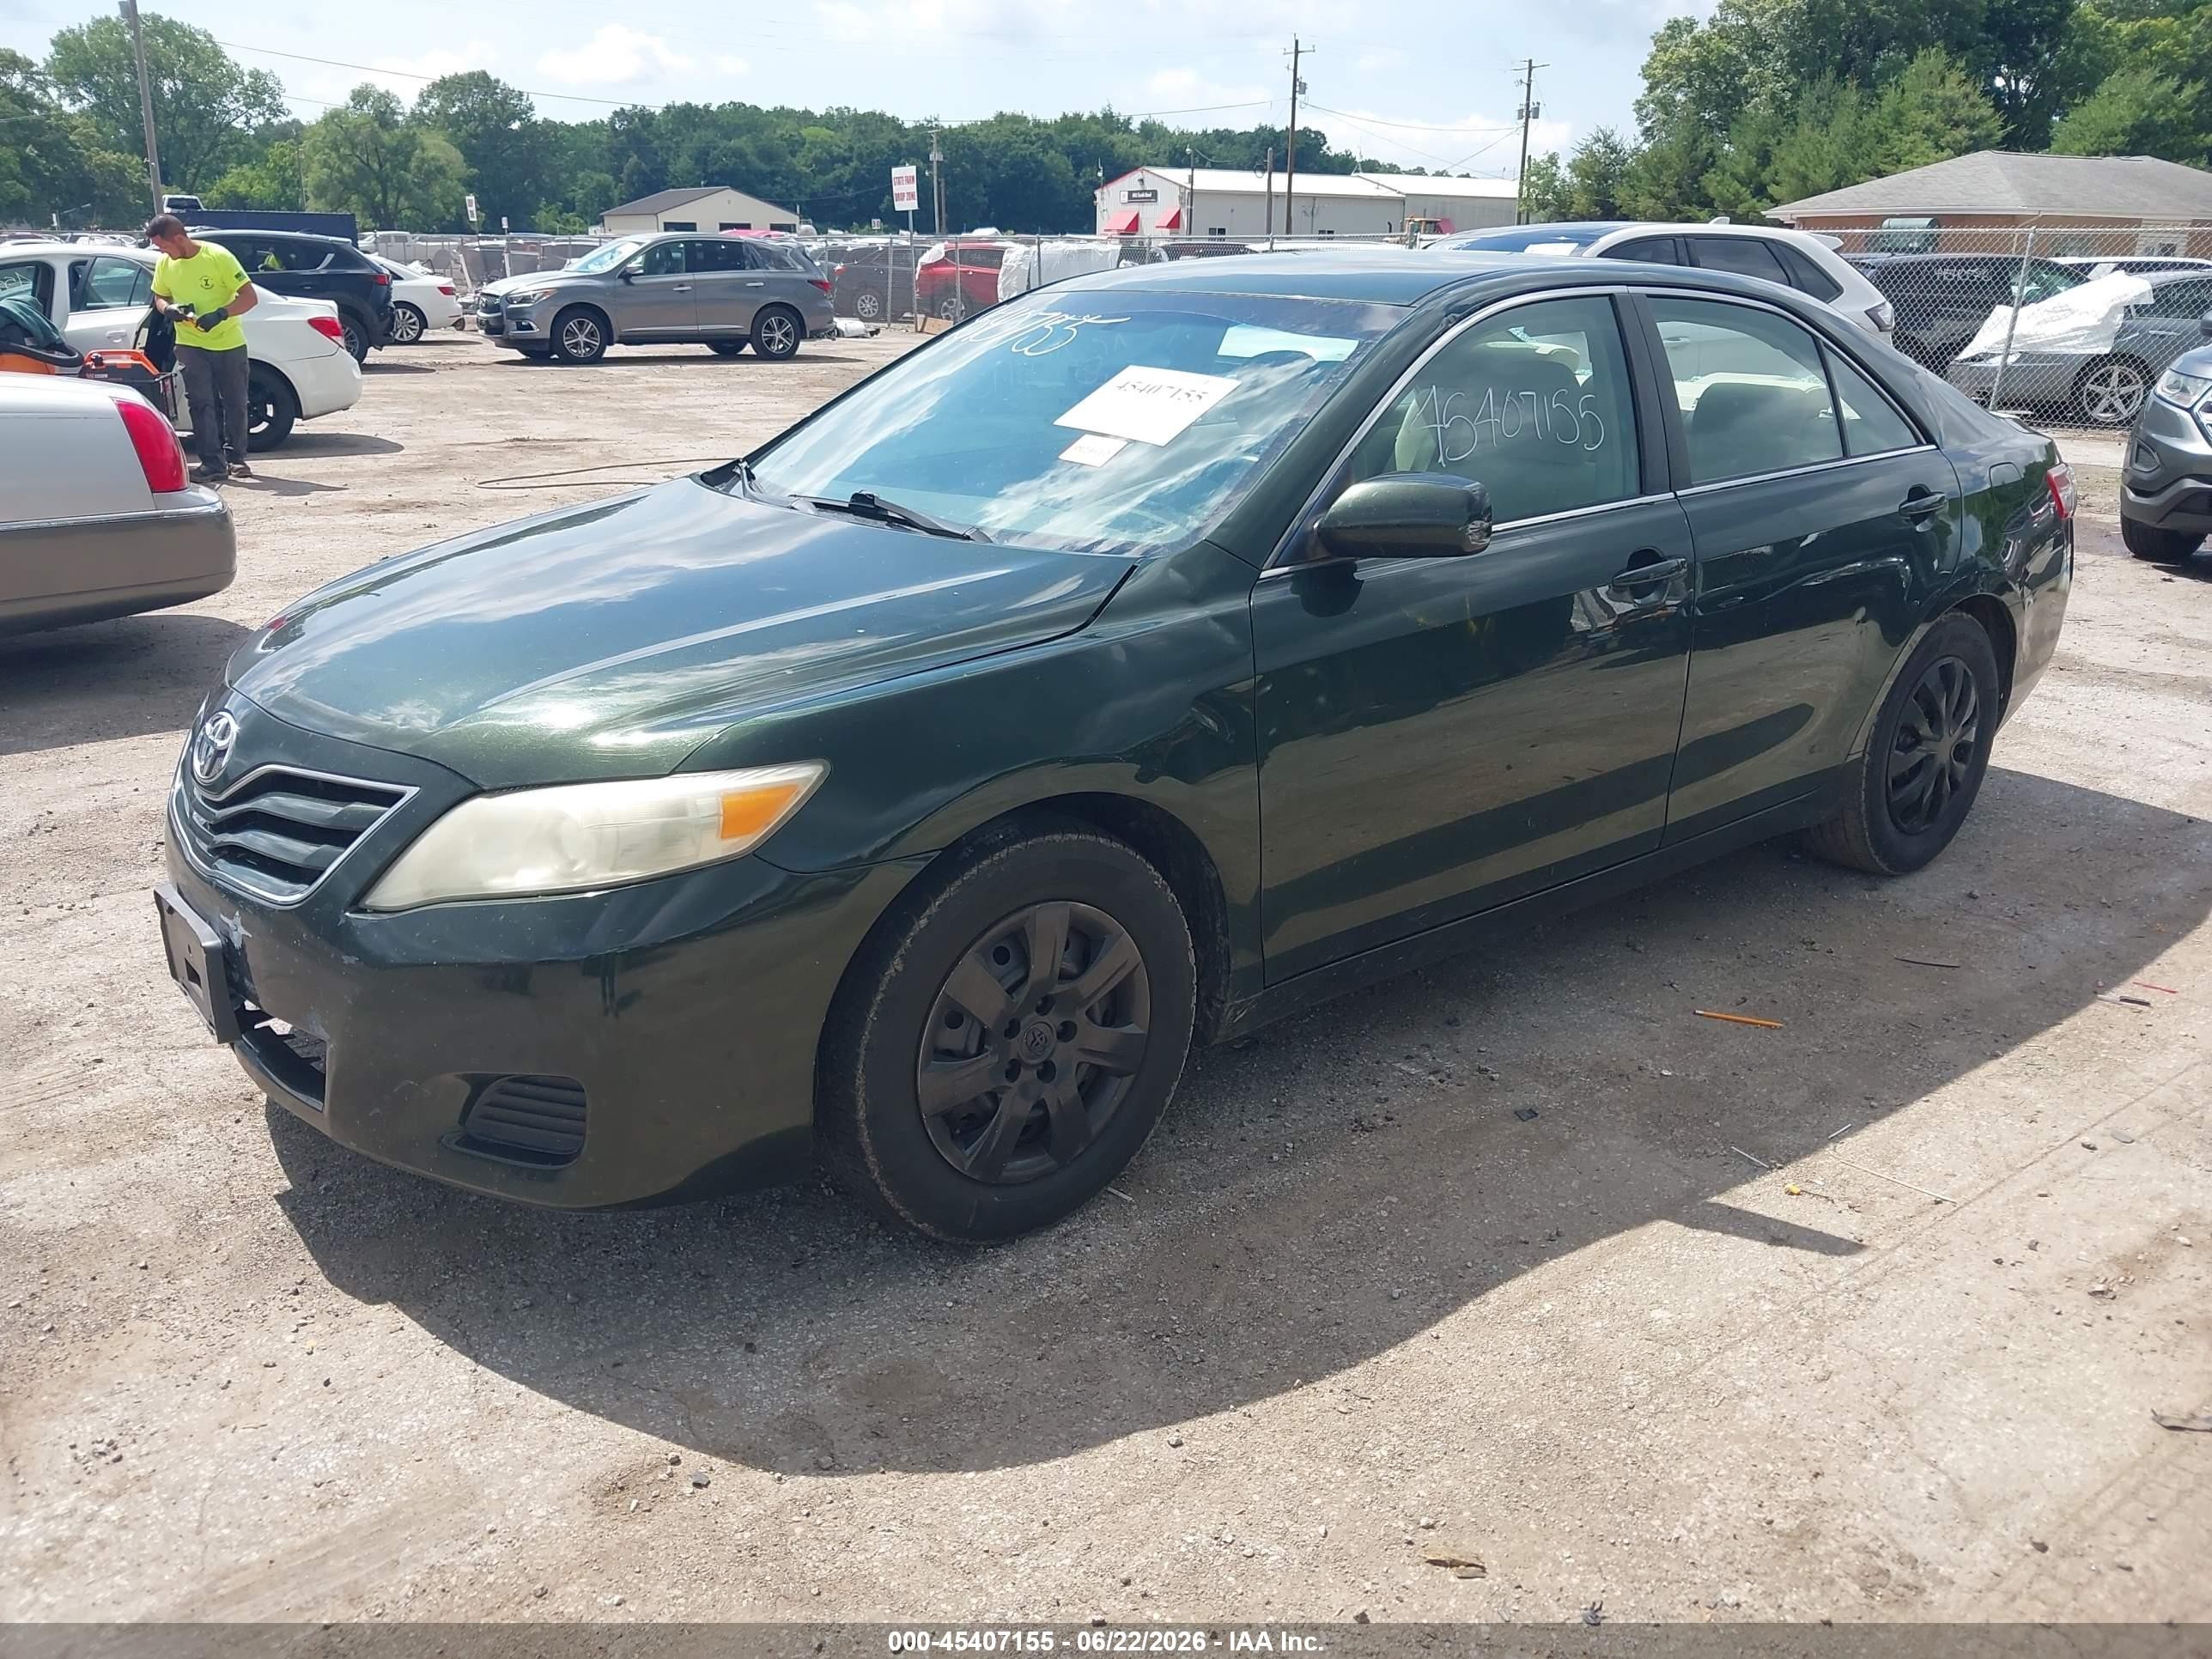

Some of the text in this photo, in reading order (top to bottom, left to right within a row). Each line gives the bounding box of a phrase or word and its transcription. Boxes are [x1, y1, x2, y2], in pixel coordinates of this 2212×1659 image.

[893, 175, 915, 185] STATE FARM
[1411, 385, 1605, 467] 45407155
